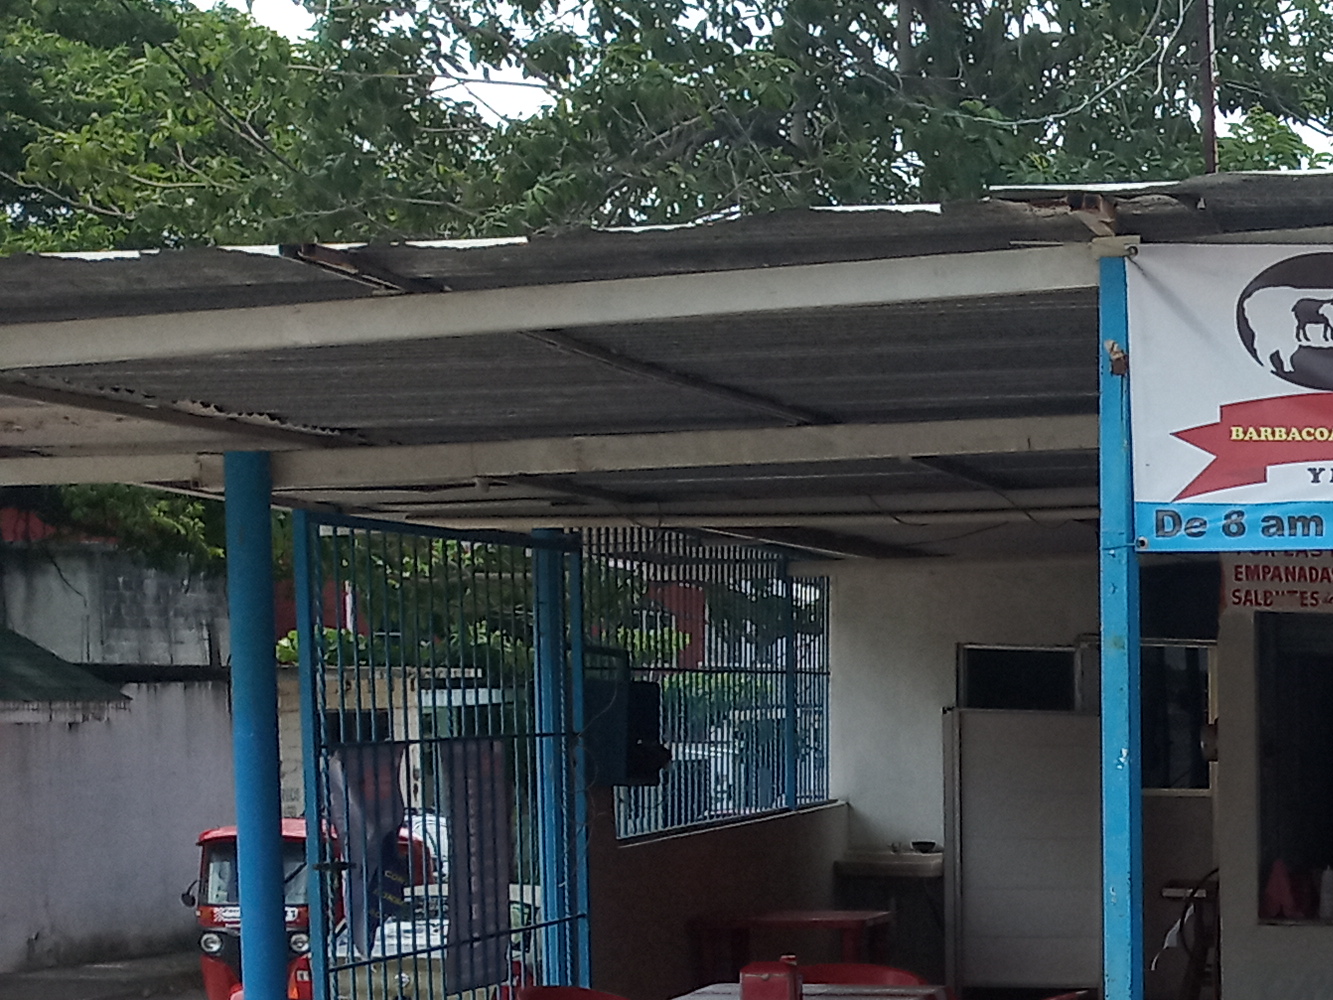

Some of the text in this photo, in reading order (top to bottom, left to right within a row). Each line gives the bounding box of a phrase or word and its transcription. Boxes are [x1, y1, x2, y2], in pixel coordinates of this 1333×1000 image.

[1307, 467, 1327, 484] Y
[1153, 508, 1208, 539] De
[1221, 509, 1247, 539] 8
[1260, 513, 1325, 538] am
[1231, 588, 1320, 608] SALBES
